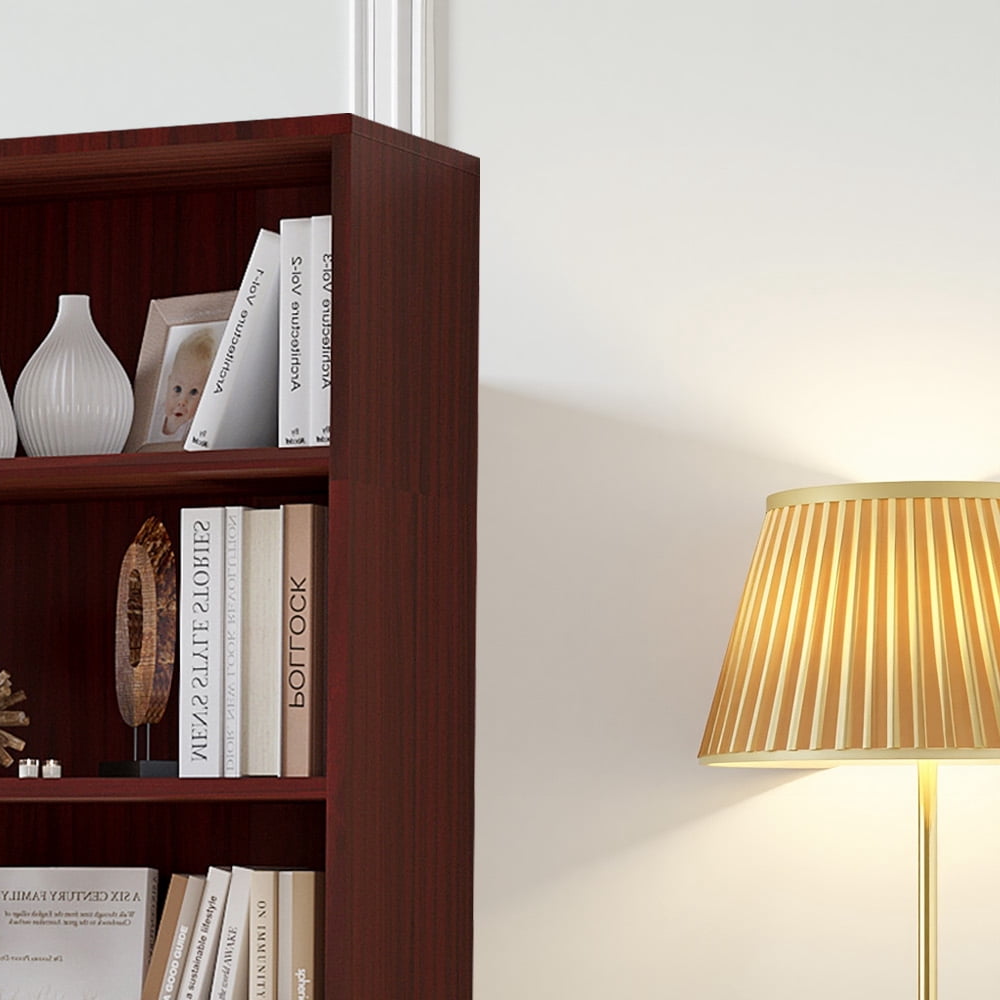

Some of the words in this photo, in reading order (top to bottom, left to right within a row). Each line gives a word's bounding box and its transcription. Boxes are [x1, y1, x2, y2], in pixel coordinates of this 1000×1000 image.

[200, 896, 218, 934] lifestyle
[257, 900, 265, 918] ON
[166, 960, 180, 992] GOOD
[173, 925, 188, 959] GUIDE
[188, 935, 207, 990] sustainable
[223, 926, 237, 968] AWAKE
[256, 926, 266, 998] IMMUNITY
[186, 992, 192, 1000] a
